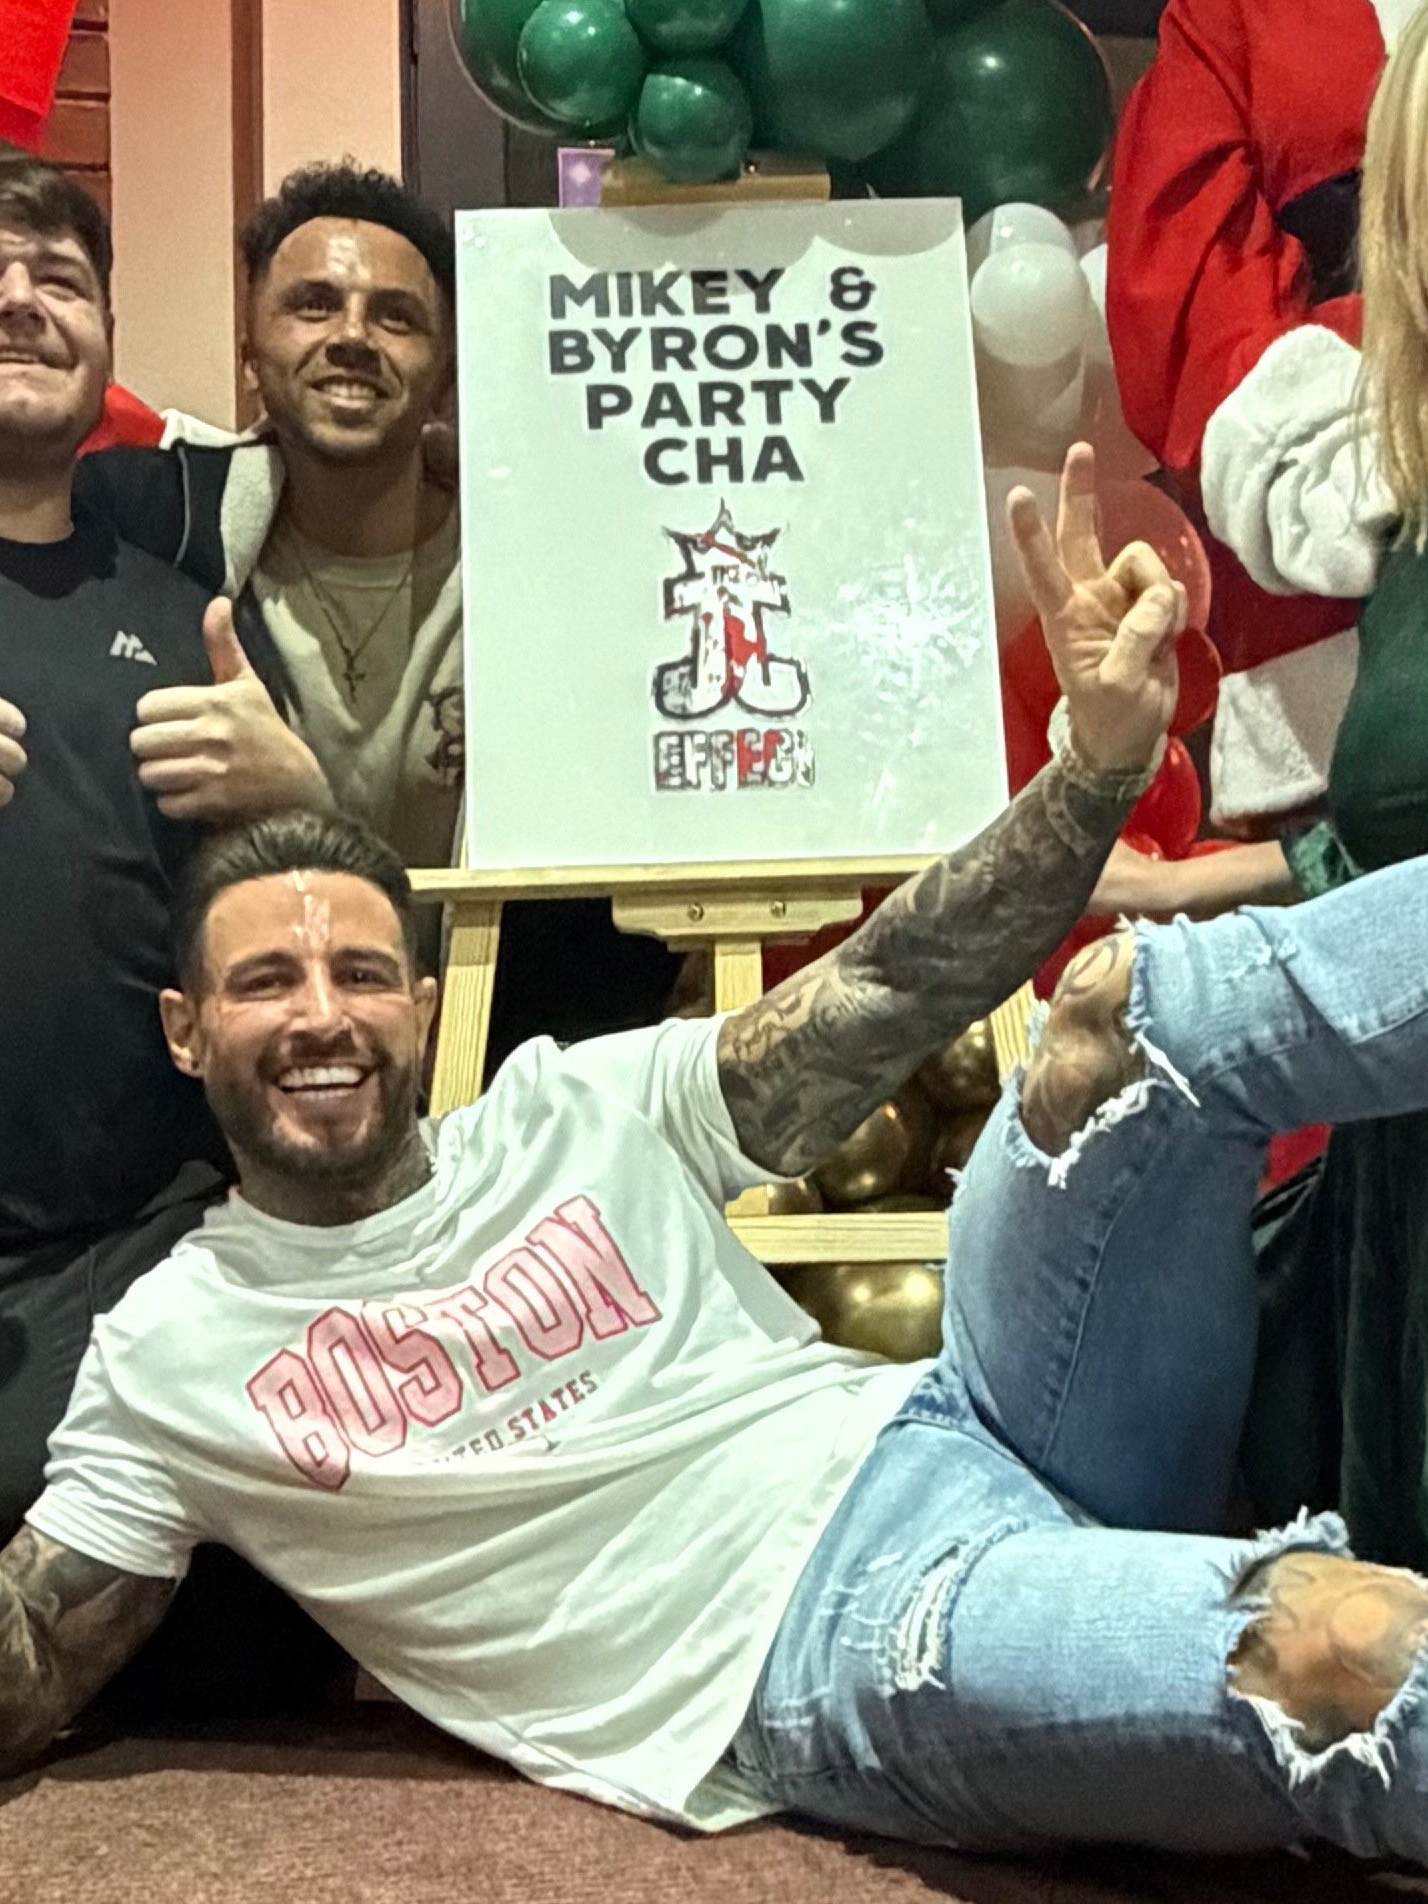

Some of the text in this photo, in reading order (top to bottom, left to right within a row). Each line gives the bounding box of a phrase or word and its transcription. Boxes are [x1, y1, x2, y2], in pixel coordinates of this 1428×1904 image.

[548, 265, 877, 321] MIKEY &
[548, 318, 885, 376] BYRON'S
[586, 376, 852, 430] PARTY
[642, 434, 805, 487] CHA
[246, 1195, 662, 1493] BOSTON
[507, 1369, 598, 1442] STATES
